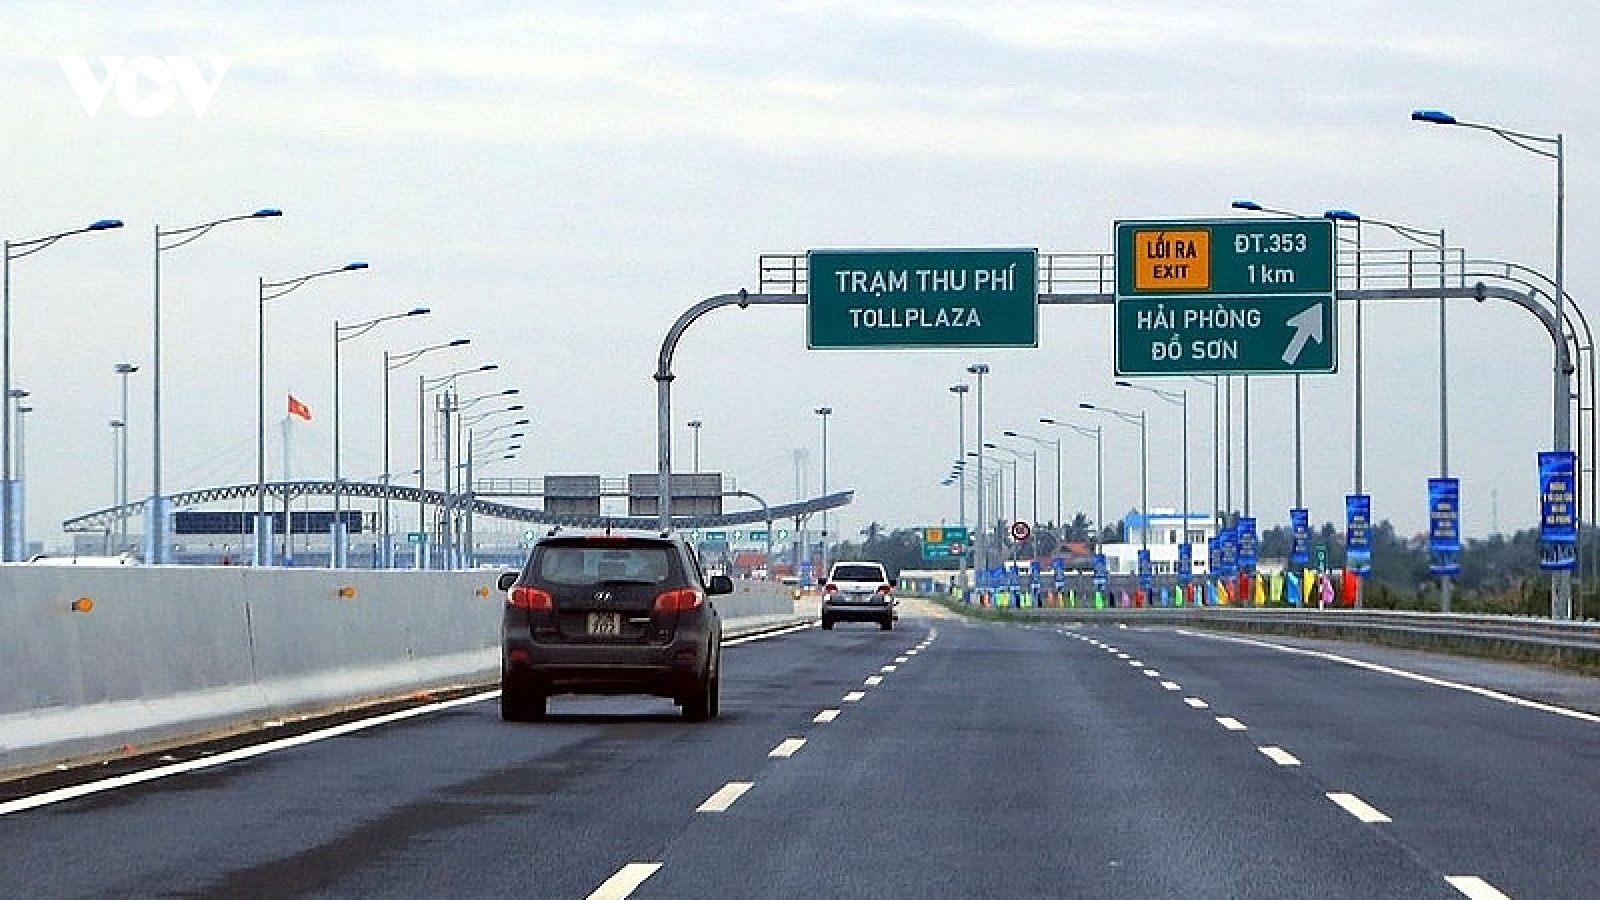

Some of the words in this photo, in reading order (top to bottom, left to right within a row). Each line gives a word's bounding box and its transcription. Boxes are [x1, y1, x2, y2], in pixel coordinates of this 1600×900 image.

[1147, 232, 1170, 258] LỐI
[1175, 240, 1197, 258] RA
[1234, 233, 1307, 253] ĐT.353
[835, 269, 908, 297] TRẠM
[915, 269, 967, 291] THU
[974, 262, 1016, 291] PHÍ
[1153, 264, 1189, 279] EXIT
[1137, 304, 1175, 330] HẢI
[1183, 304, 1261, 329] PHÒNG
[1191, 338, 1239, 359] SƠN
